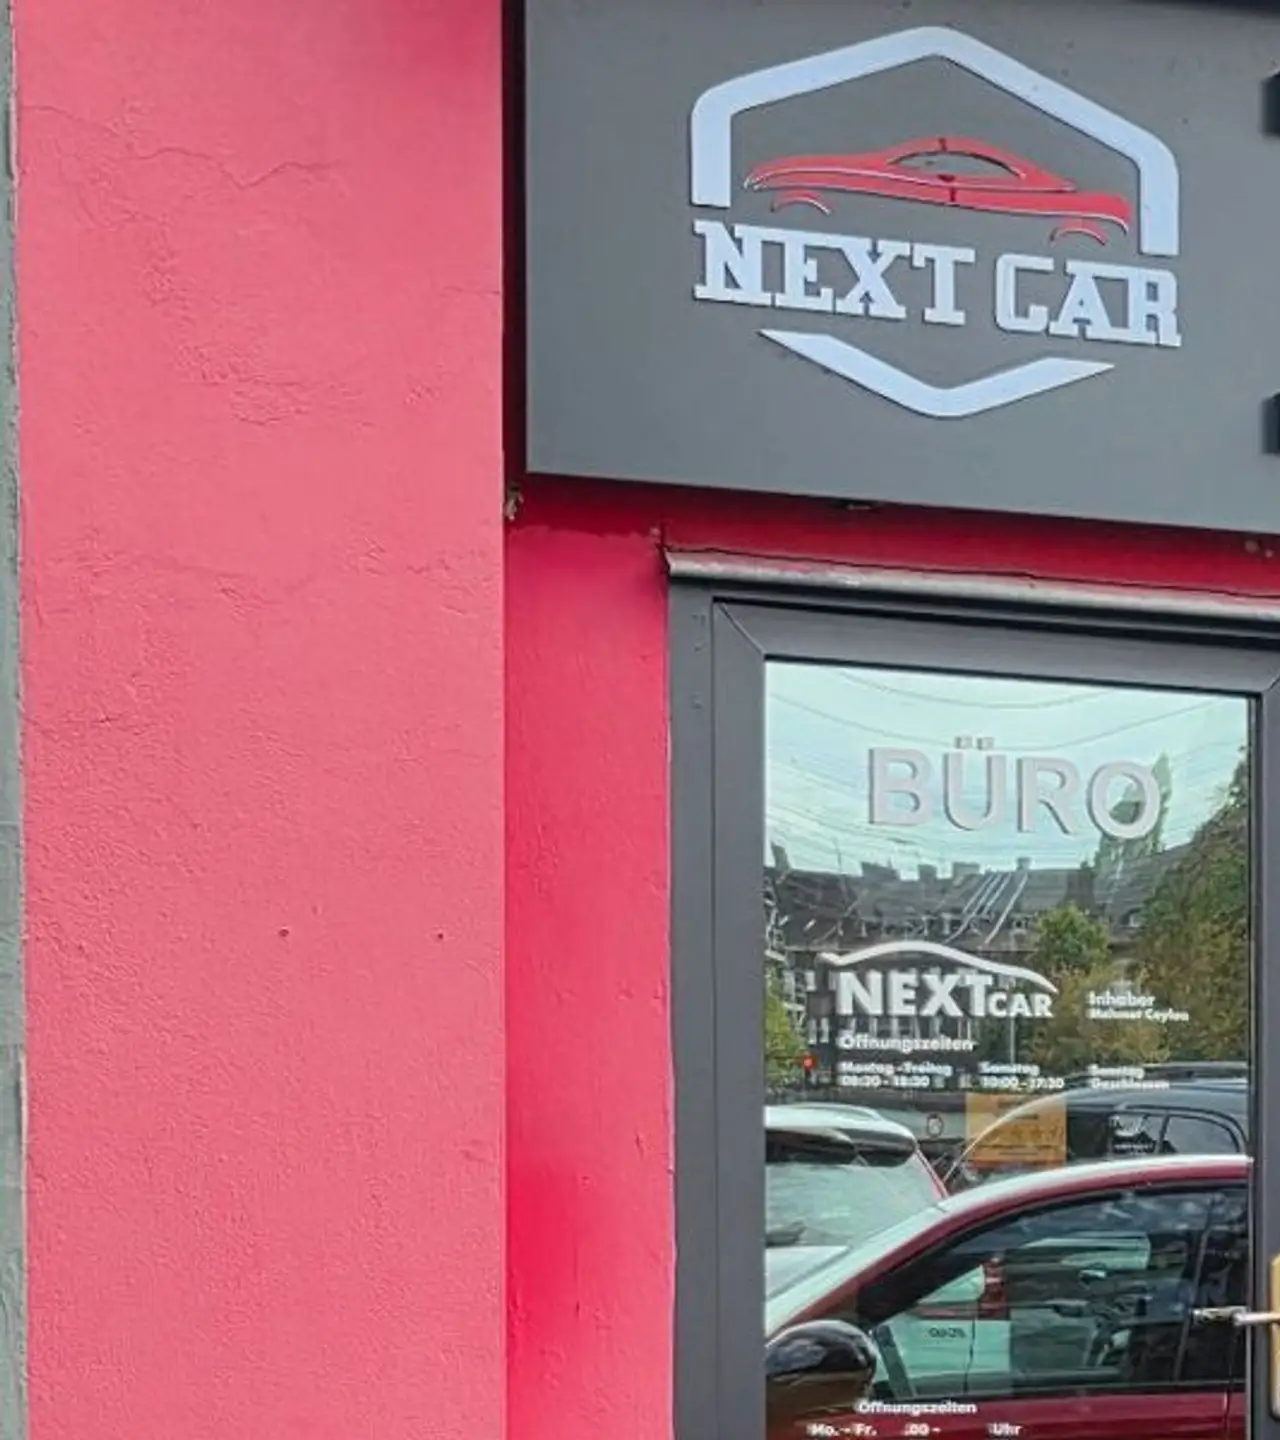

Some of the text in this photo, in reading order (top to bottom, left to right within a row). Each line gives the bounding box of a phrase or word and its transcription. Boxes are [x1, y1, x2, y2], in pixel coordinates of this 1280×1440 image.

[692, 218, 1182, 348] NEXT CAR
[866, 735, 1164, 840] BÜRO
[836, 1029, 974, 1054] Öffnungszeiten
[857, 1399, 977, 1416] Öffnungszeiten
[989, 1422, 1023, 1436] Uhr
